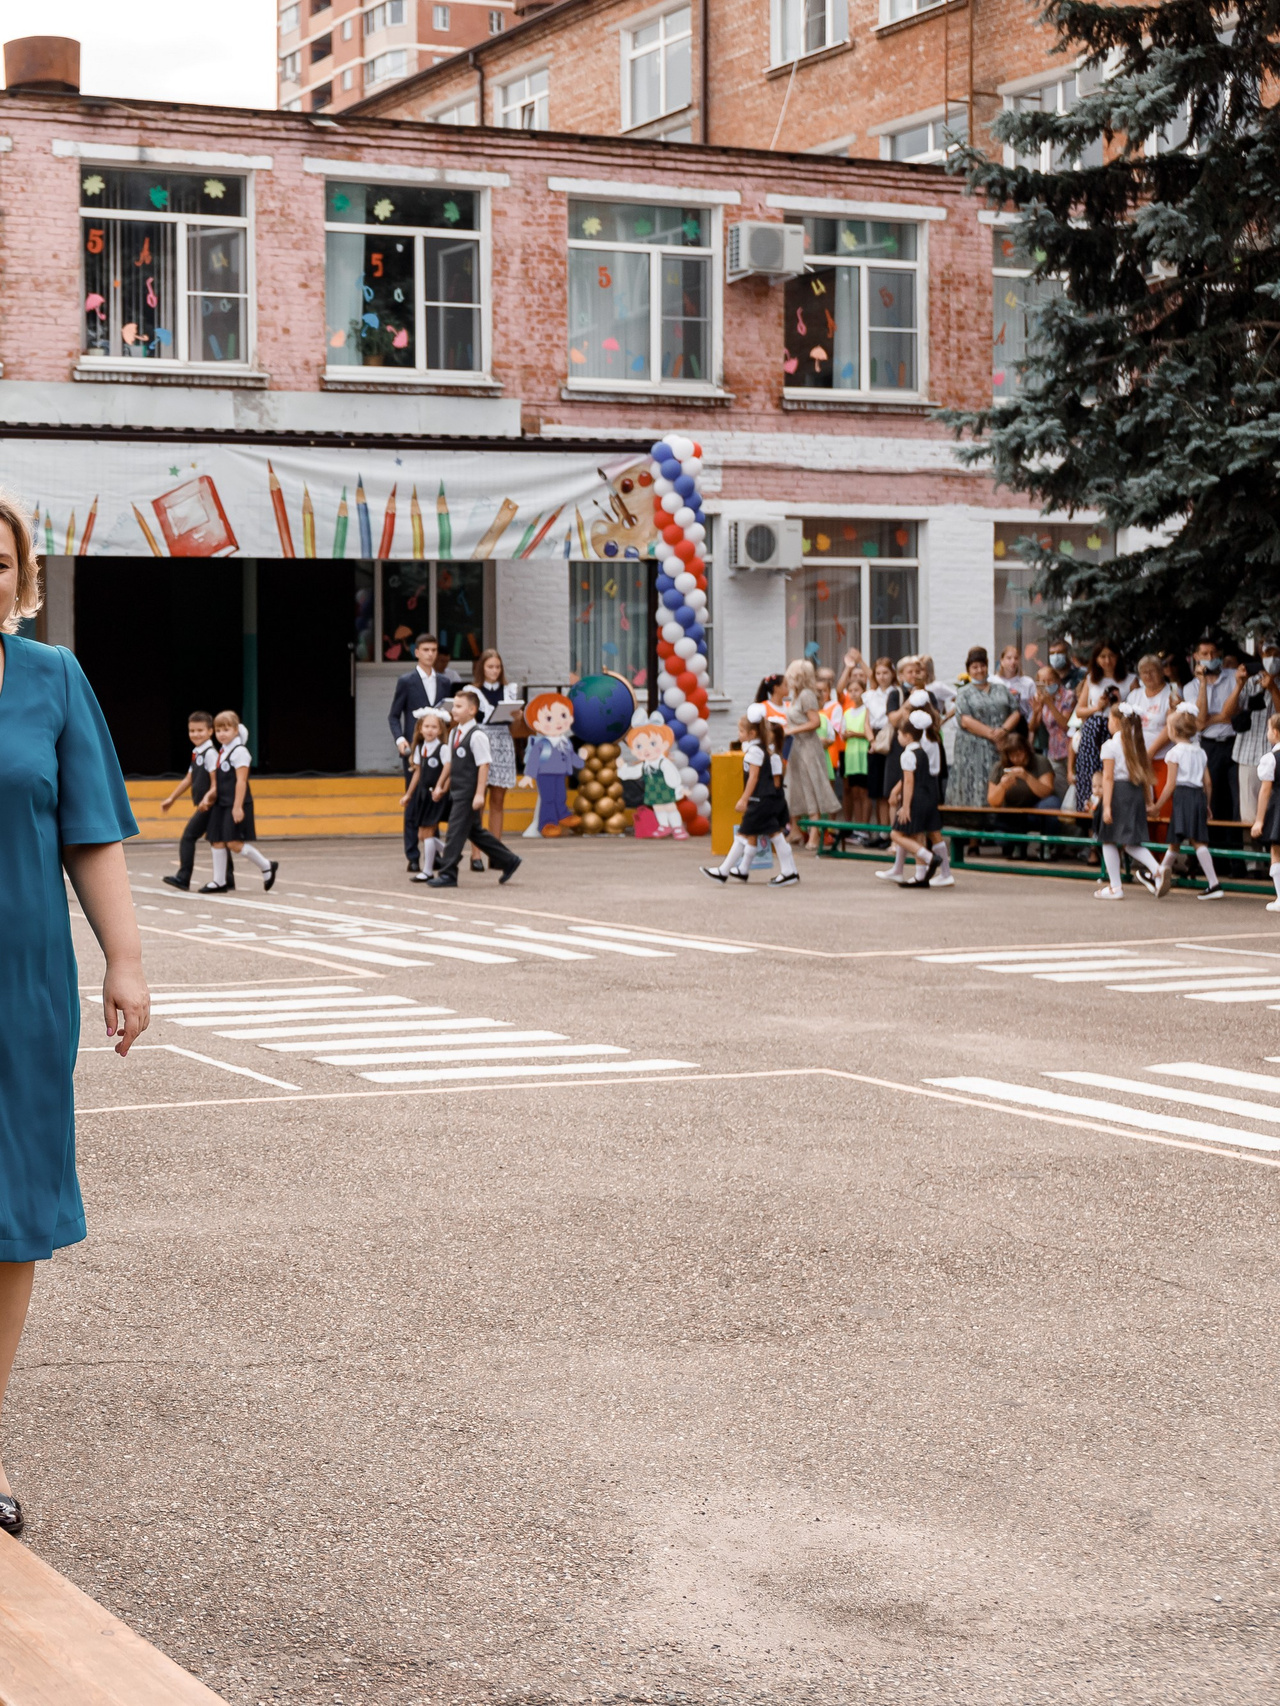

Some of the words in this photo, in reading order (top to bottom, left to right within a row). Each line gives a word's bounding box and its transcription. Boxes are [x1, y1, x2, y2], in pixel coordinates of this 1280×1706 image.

[86, 228, 105, 254] 5
[371, 253, 384, 277] 5
[598, 266, 612, 289] 5
[604, 578, 618, 598] 4
